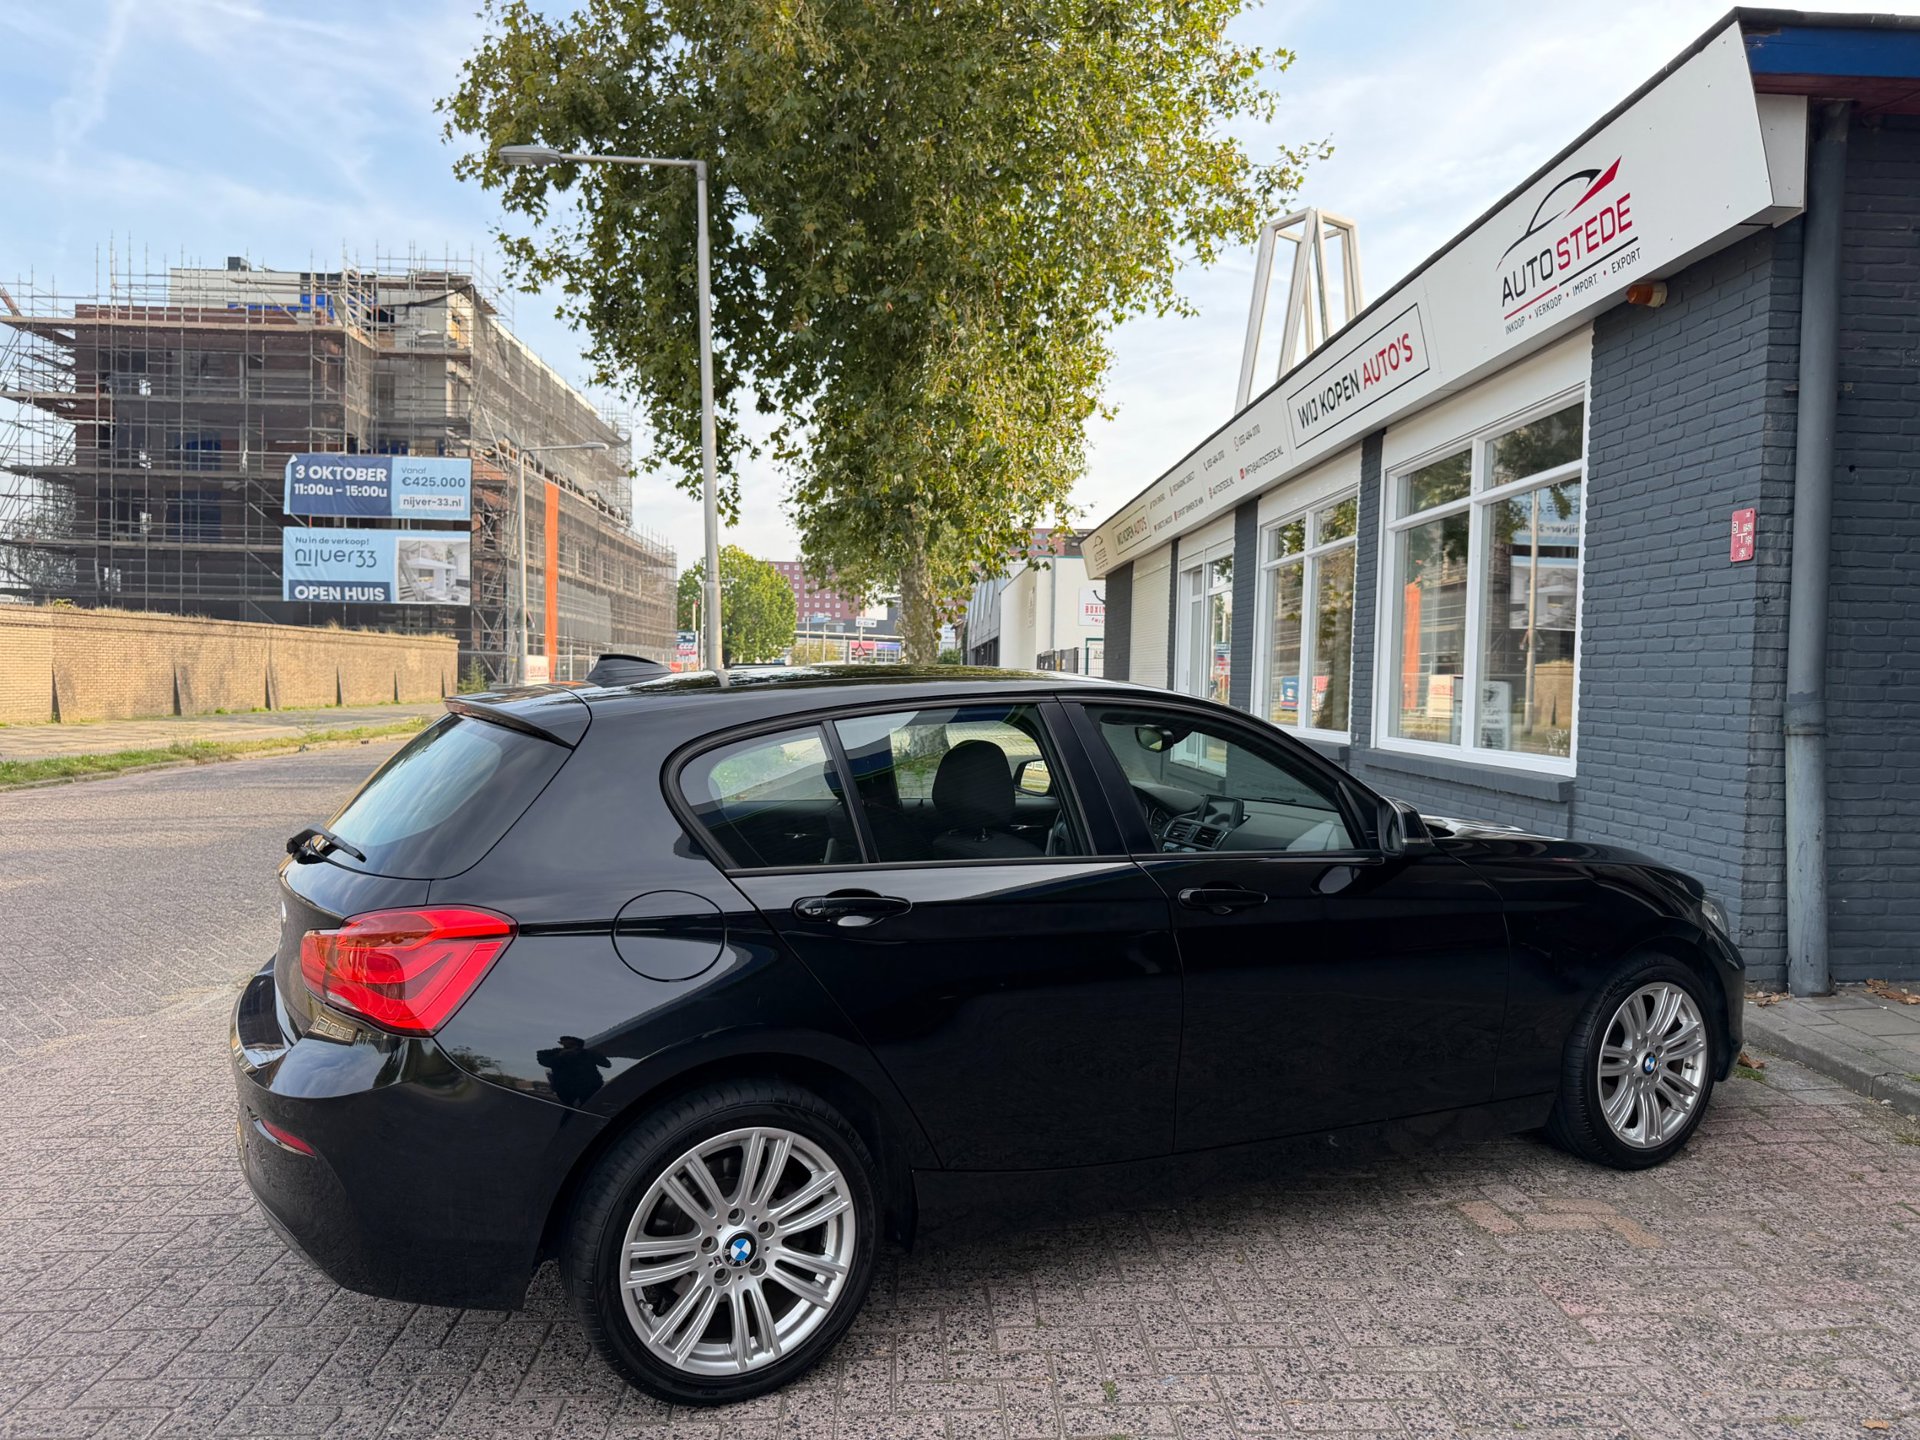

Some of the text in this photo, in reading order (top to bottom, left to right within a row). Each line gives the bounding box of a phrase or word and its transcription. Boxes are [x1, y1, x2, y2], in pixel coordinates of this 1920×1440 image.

[1505, 247, 1641, 335] INKOOP VERKOOP IMPORT EXPORT
[1297, 332, 1414, 430] WIJ KOPEN AUTO'S
[295, 465, 387, 482] 3 OKTOBER
[401, 467, 427, 475] Vanaf
[402, 477, 466, 488] €425.000
[294, 483, 333, 496] 11:00u
[345, 485, 388, 497] 15:00u
[403, 497, 462, 508] nijver-33.nl
[308, 536, 317, 544] in
[332, 537, 369, 546] verkoop!
[294, 585, 385, 600] OPEN HUIS
[1085, 605, 1105, 614] BOXIN
